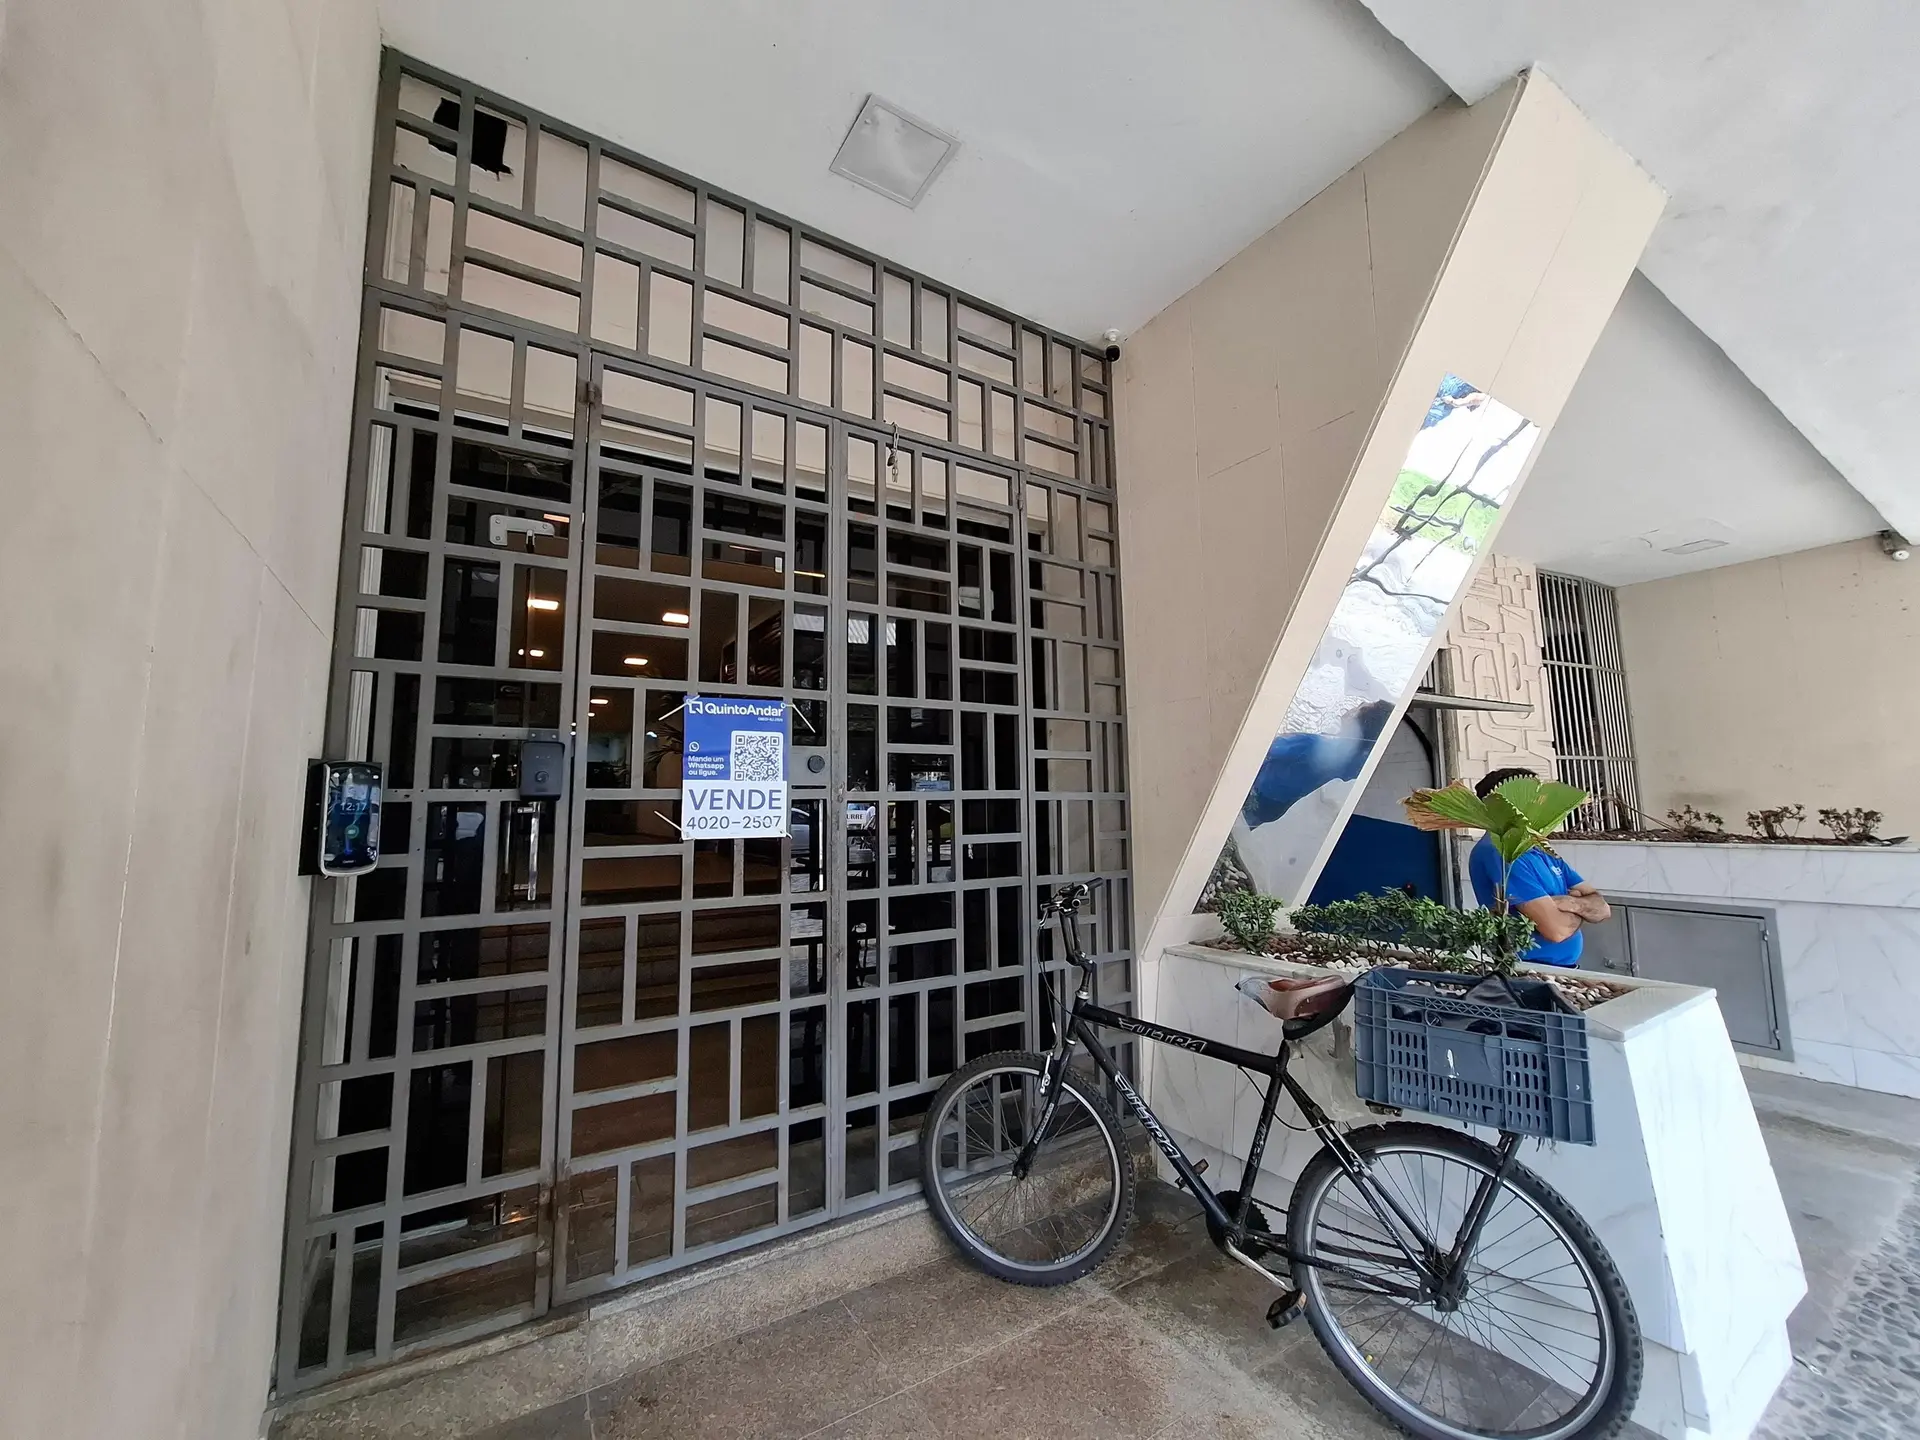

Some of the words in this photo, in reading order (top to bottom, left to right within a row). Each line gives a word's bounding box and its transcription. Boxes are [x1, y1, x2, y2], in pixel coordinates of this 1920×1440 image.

[705, 702, 784, 717] QuintoAndar
[688, 762, 724, 770] Whatsapp
[698, 769, 718, 777] ligue.
[688, 789, 782, 811] VENDE
[340, 802, 367, 811] 12:17
[686, 815, 782, 830] 4020-2507
